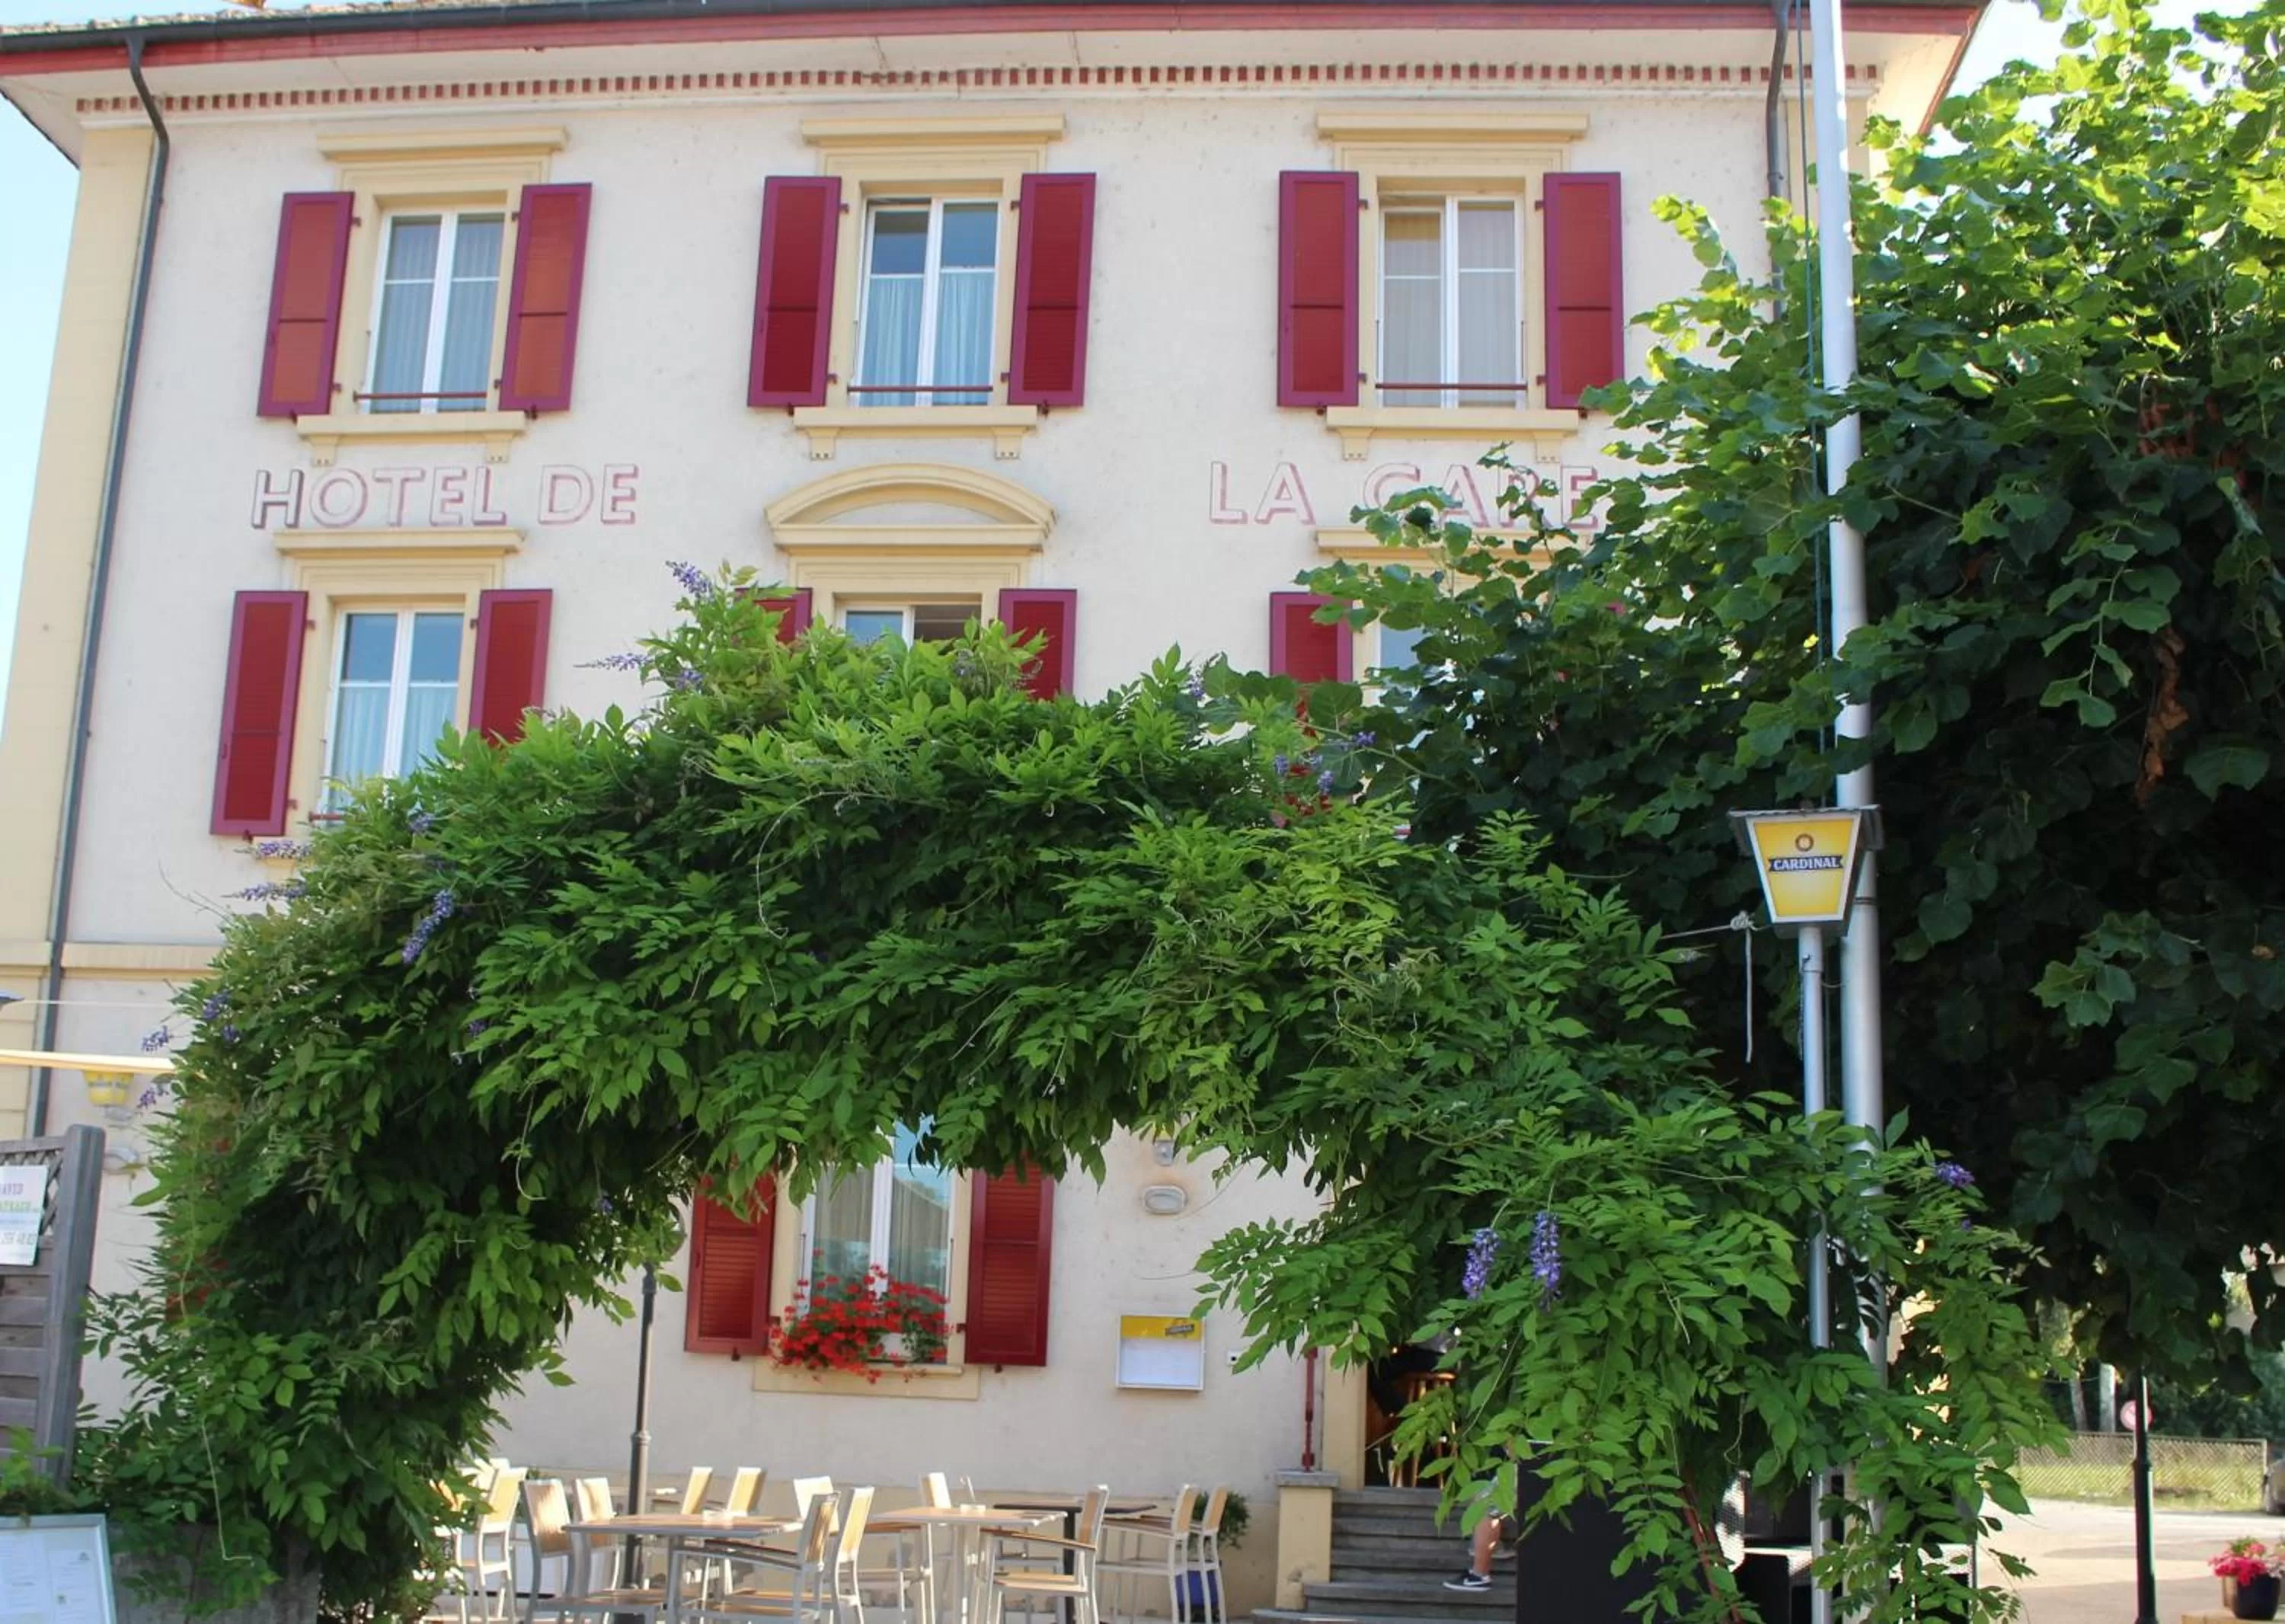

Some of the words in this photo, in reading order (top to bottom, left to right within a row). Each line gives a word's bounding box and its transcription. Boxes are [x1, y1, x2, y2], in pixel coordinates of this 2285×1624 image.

[251, 465, 507, 529] HOTEL
[537, 464, 638, 525] DE
[1209, 461, 1316, 525] LA
[1772, 857, 1839, 871] CARDINAL
